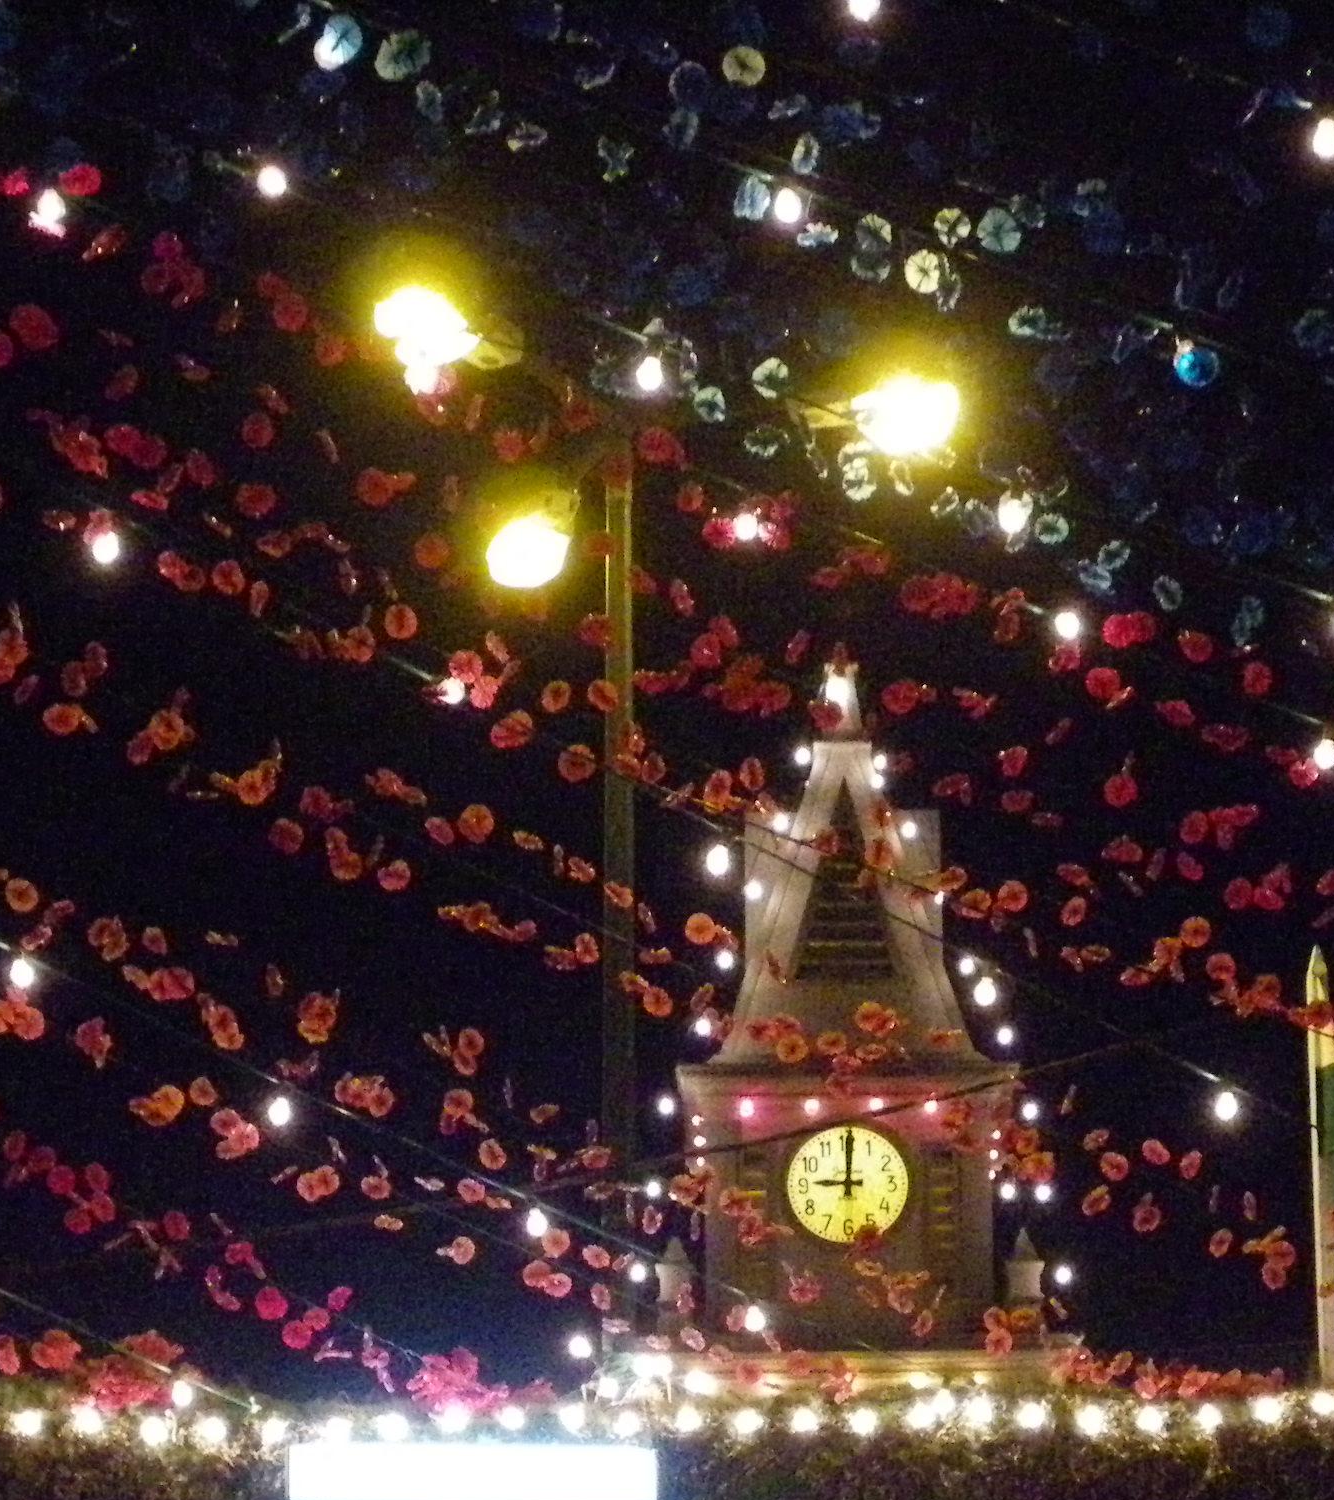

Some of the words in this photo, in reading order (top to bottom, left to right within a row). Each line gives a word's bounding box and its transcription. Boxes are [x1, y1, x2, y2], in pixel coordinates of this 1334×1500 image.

[819, 1141, 831, 1157] 11
[839, 1135, 855, 1151] 1
[865, 1140, 872, 1156] 1
[802, 1156, 818, 1173] 10
[881, 1155, 891, 1172] 2
[798, 1178, 809, 1194] 9
[887, 1175, 897, 1192] 3
[805, 1198, 815, 1215] 8
[879, 1197, 890, 1214] 4
[822, 1214, 832, 1231] 7
[843, 1219, 854, 1236] 6
[865, 1213, 876, 1226] 5
